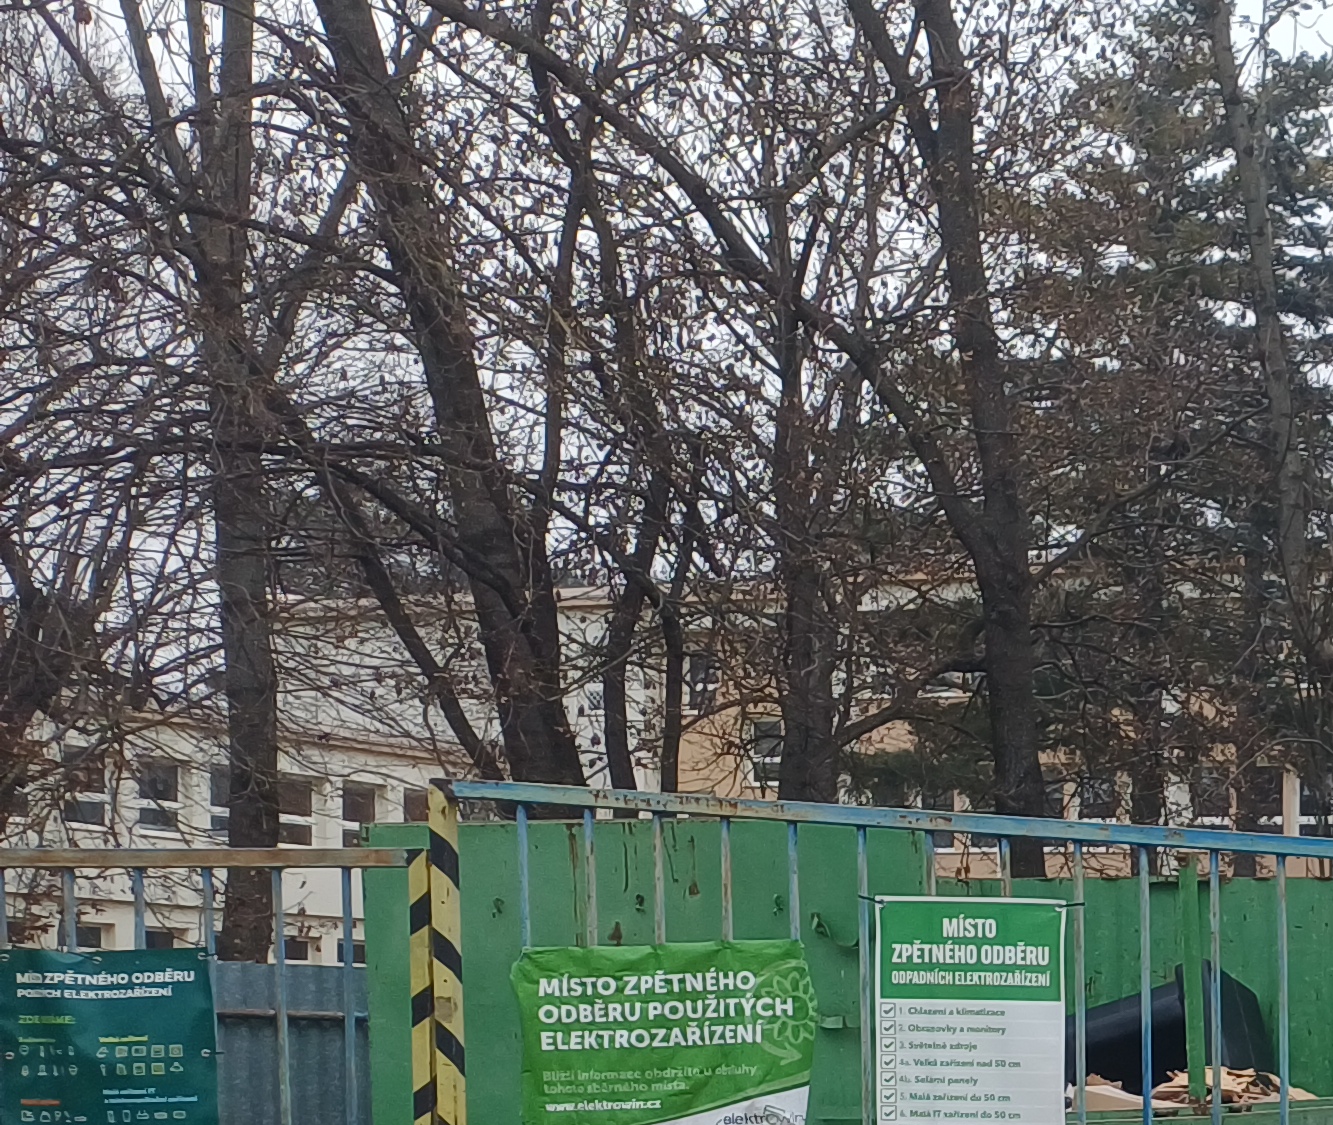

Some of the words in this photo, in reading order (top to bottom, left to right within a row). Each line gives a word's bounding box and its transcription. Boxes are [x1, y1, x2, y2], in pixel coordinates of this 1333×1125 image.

[942, 914, 996, 938] MÍSTO
[892, 940, 977, 964] ZPĚTNÉHO
[981, 942, 1049, 966] ODBĚRU
[43, 970, 128, 985] ZPĚTNÉHO
[131, 968, 195, 983] ODBĚRU
[538, 973, 616, 997] MÍSTO
[623, 968, 756, 996] ZPĚTNÉHO
[892, 968, 953, 985] ODPADNÍCH
[954, 970, 1050, 987] ELEKTROZAŘÍZENÍ
[64, 985, 172, 999] ELEKTROZAŘÍZENÍ
[538, 1000, 641, 1024] ODBĚRU
[648, 994, 794, 1021] POUŽITÝCH
[540, 1020, 763, 1051] ELEKTROZAŘÍZENÍ
[976, 1059, 993, 1067] nad
[994, 1059, 1006, 1067] 50
[984, 1093, 995, 1101] 50
[980, 1110, 992, 1119] do
[994, 1111, 1006, 1119] 50
